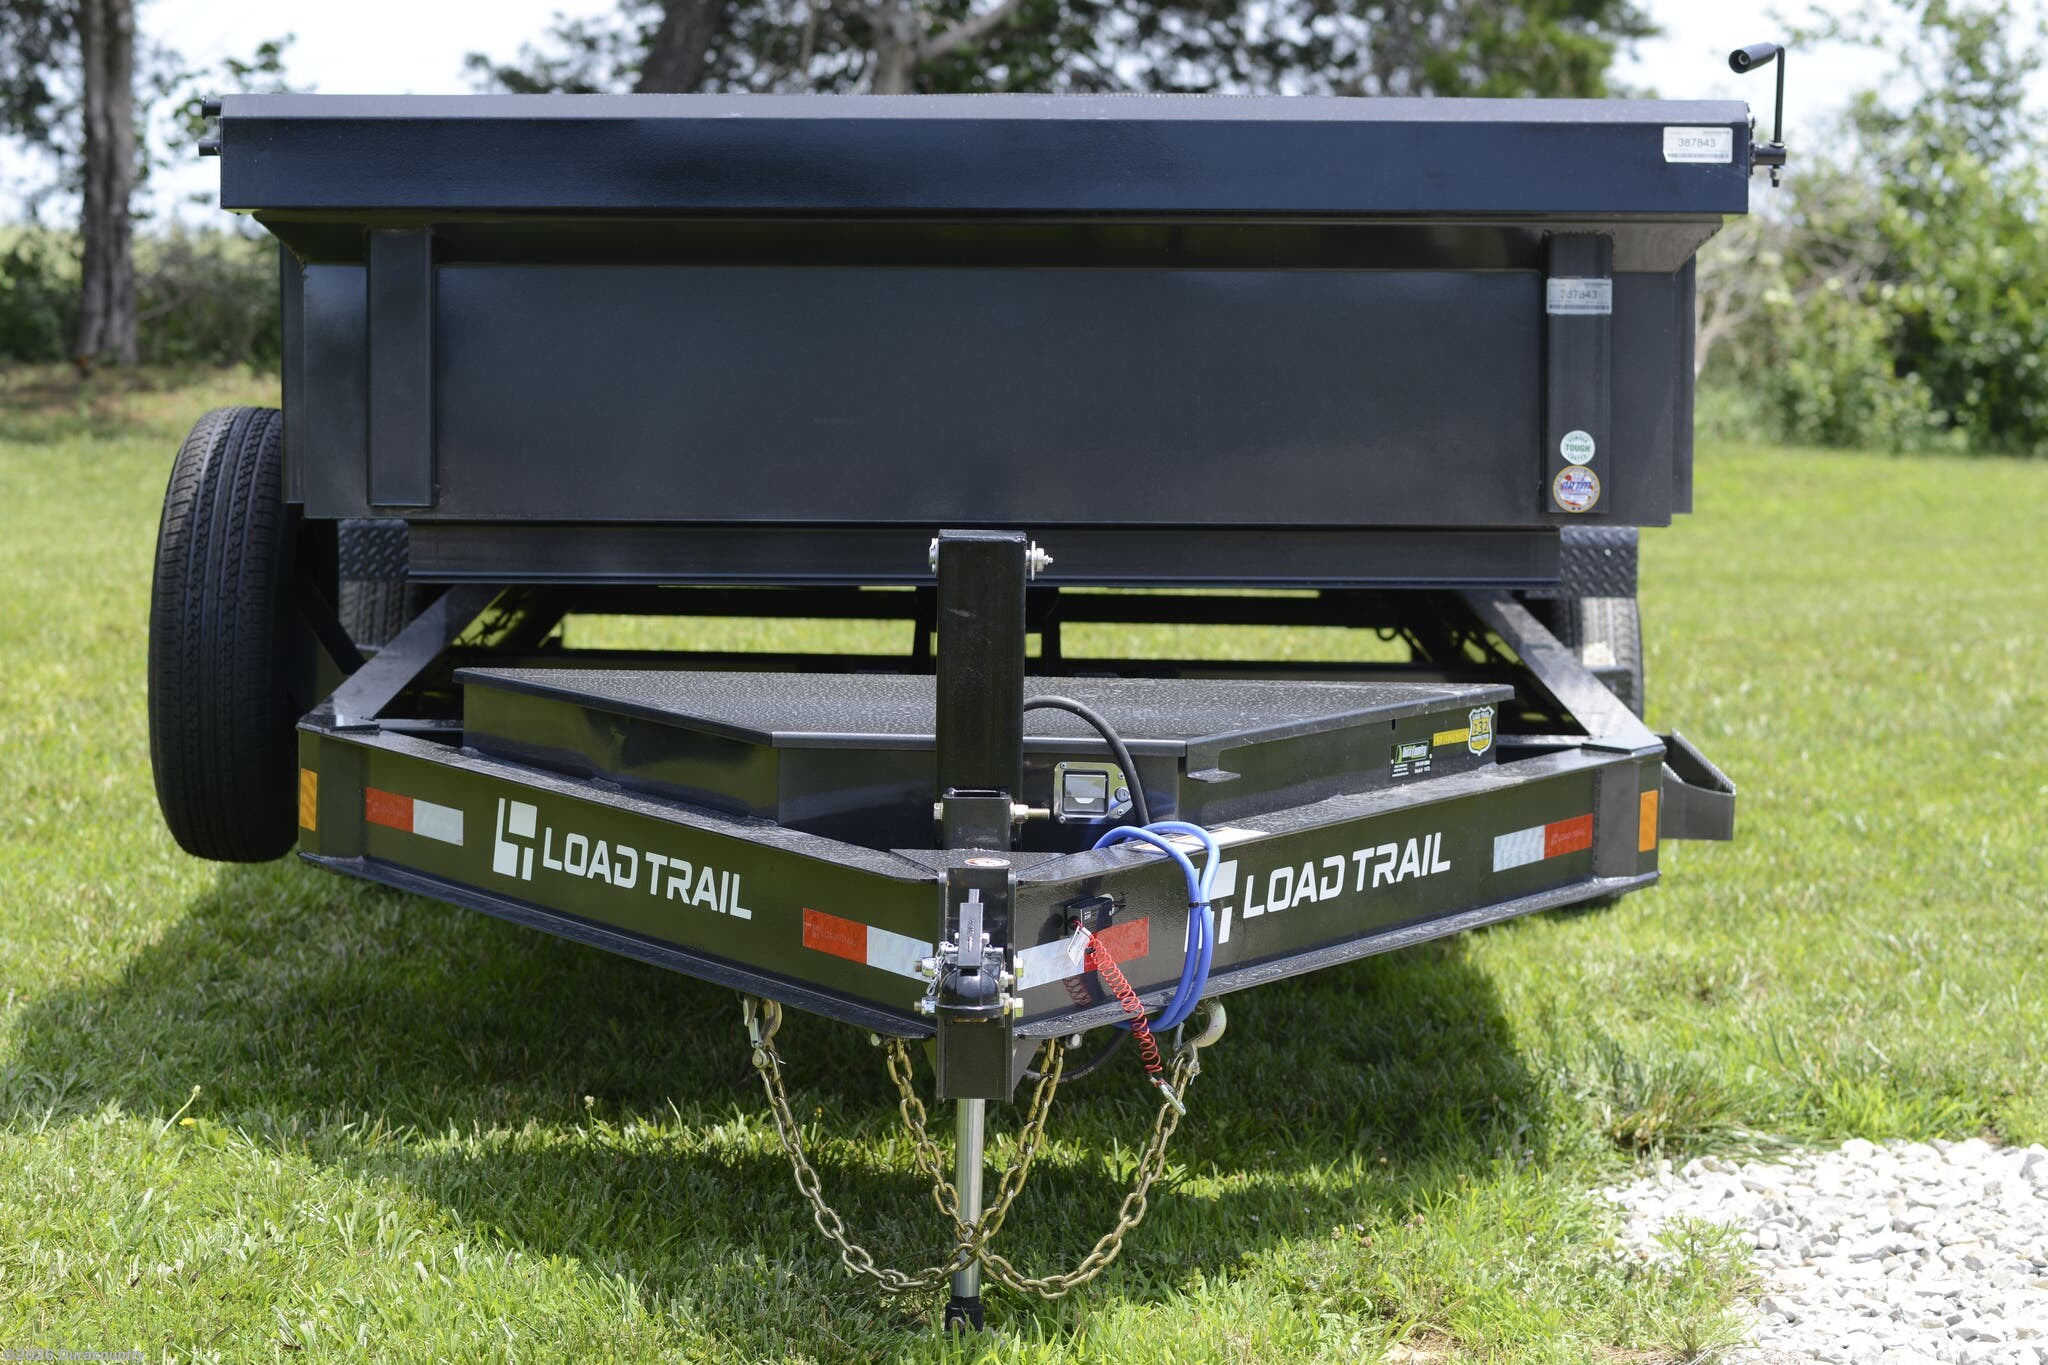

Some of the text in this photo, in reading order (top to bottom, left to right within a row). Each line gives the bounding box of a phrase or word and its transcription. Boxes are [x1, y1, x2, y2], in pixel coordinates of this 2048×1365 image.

[1565, 444, 1590, 453] TOUGH
[543, 827, 752, 920] LOAD TRAIL
[1243, 832, 1451, 919] LOAD TRAIL
